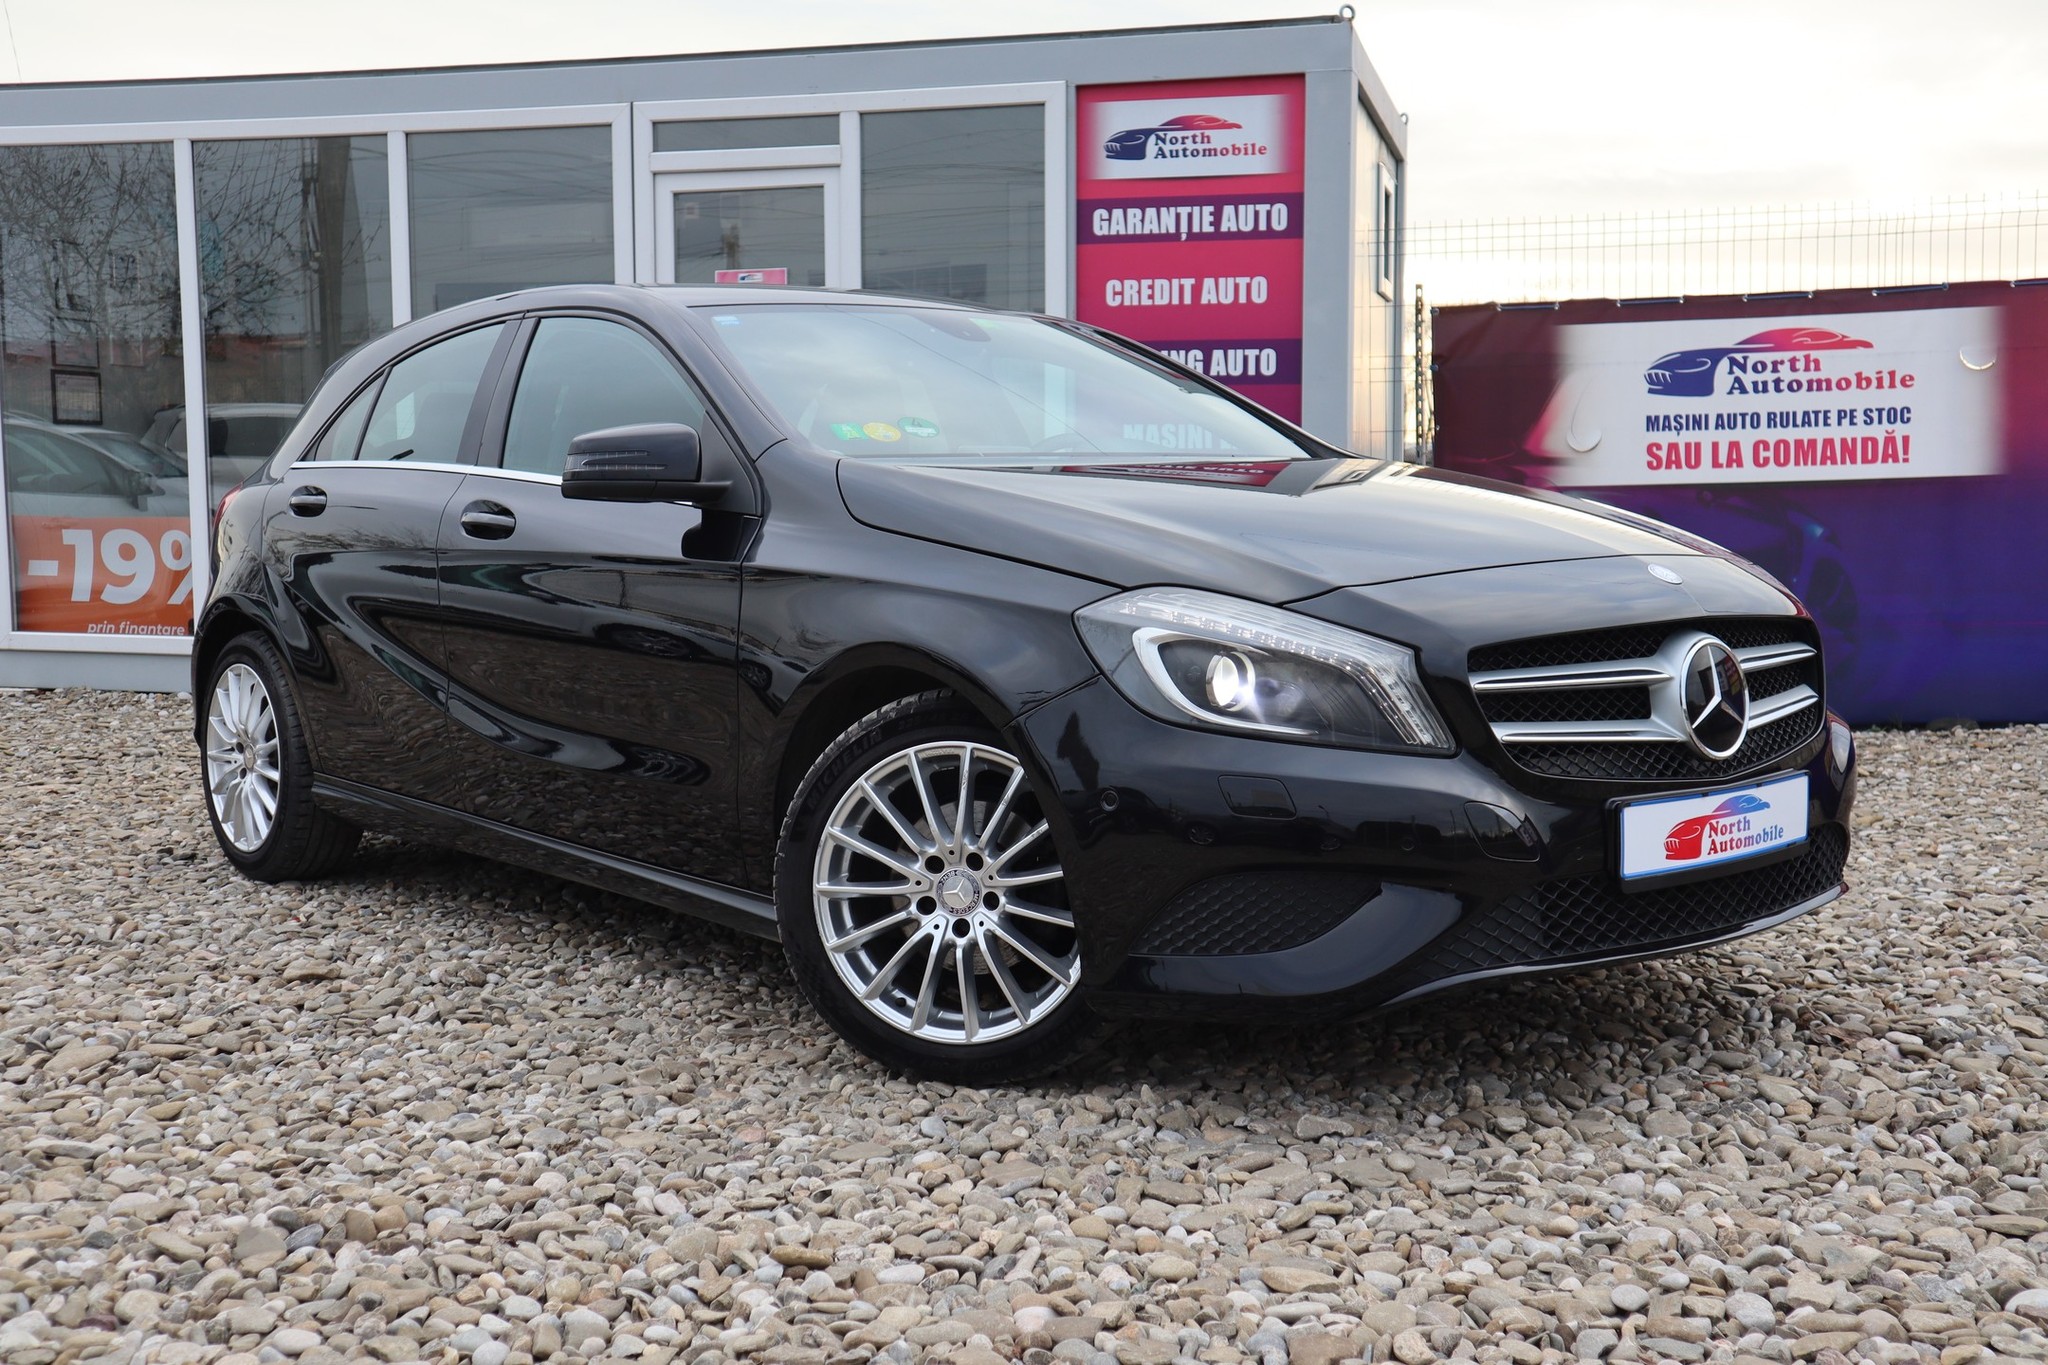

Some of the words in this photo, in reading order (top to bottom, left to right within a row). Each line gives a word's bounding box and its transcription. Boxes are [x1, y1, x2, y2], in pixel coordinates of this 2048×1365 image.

[1153, 143, 1267, 160] Automobile
[1154, 131, 1211, 147] North
[1092, 206, 1215, 241] GARANȚIE
[1220, 203, 1288, 231] AUTO
[1105, 278, 1195, 306] CREDIT
[1200, 276, 1268, 304] AUTO
[1210, 348, 1277, 376] AUTO
[1726, 353, 1822, 376] North
[1725, 370, 1915, 396] Automobile
[1645, 413, 1710, 437] MAȘINI
[1714, 412, 1762, 431] AUTO
[1766, 409, 1833, 429] RULATE
[1837, 408, 1859, 427] PE
[1863, 406, 1912, 426] STOC
[1645, 440, 1702, 471] SAU
[1711, 439, 1745, 469] LA
[1752, 429, 1911, 468] COMANDĂ!
[87, 620, 115, 635] prin
[1707, 815, 1751, 839] North
[1707, 824, 1784, 855] Automobile
